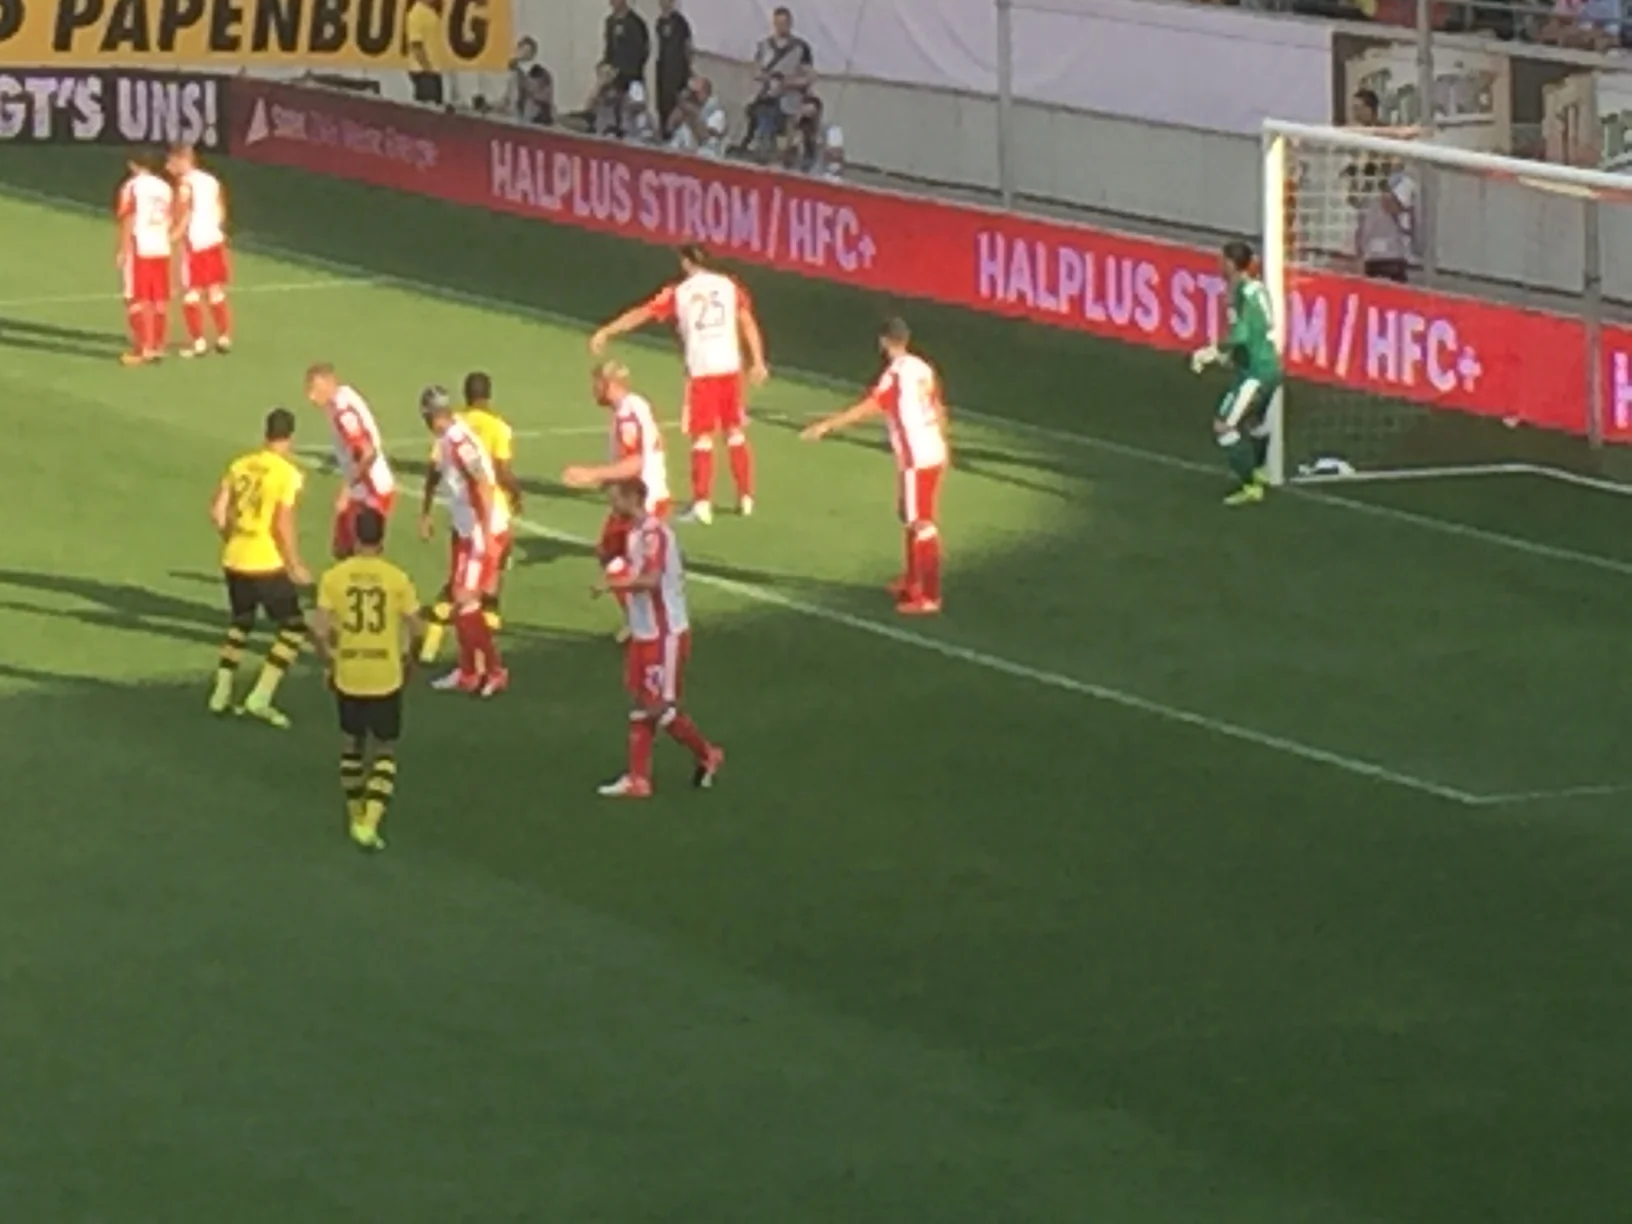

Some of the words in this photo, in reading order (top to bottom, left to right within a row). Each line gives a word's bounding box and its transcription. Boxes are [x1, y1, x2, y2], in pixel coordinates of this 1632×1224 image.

[118, 77, 217, 148] UNS!
[490, 139, 632, 225] HALPLUS
[638, 169, 761, 252] STROM
[789, 197, 876, 272] HFC+
[691, 289, 726, 332] 25
[976, 232, 1160, 332] HALPLUS
[1170, 269, 1328, 369] STM
[1334, 292, 1359, 378] /
[1367, 306, 1483, 393] HFC+
[342, 585, 387, 635] 33
